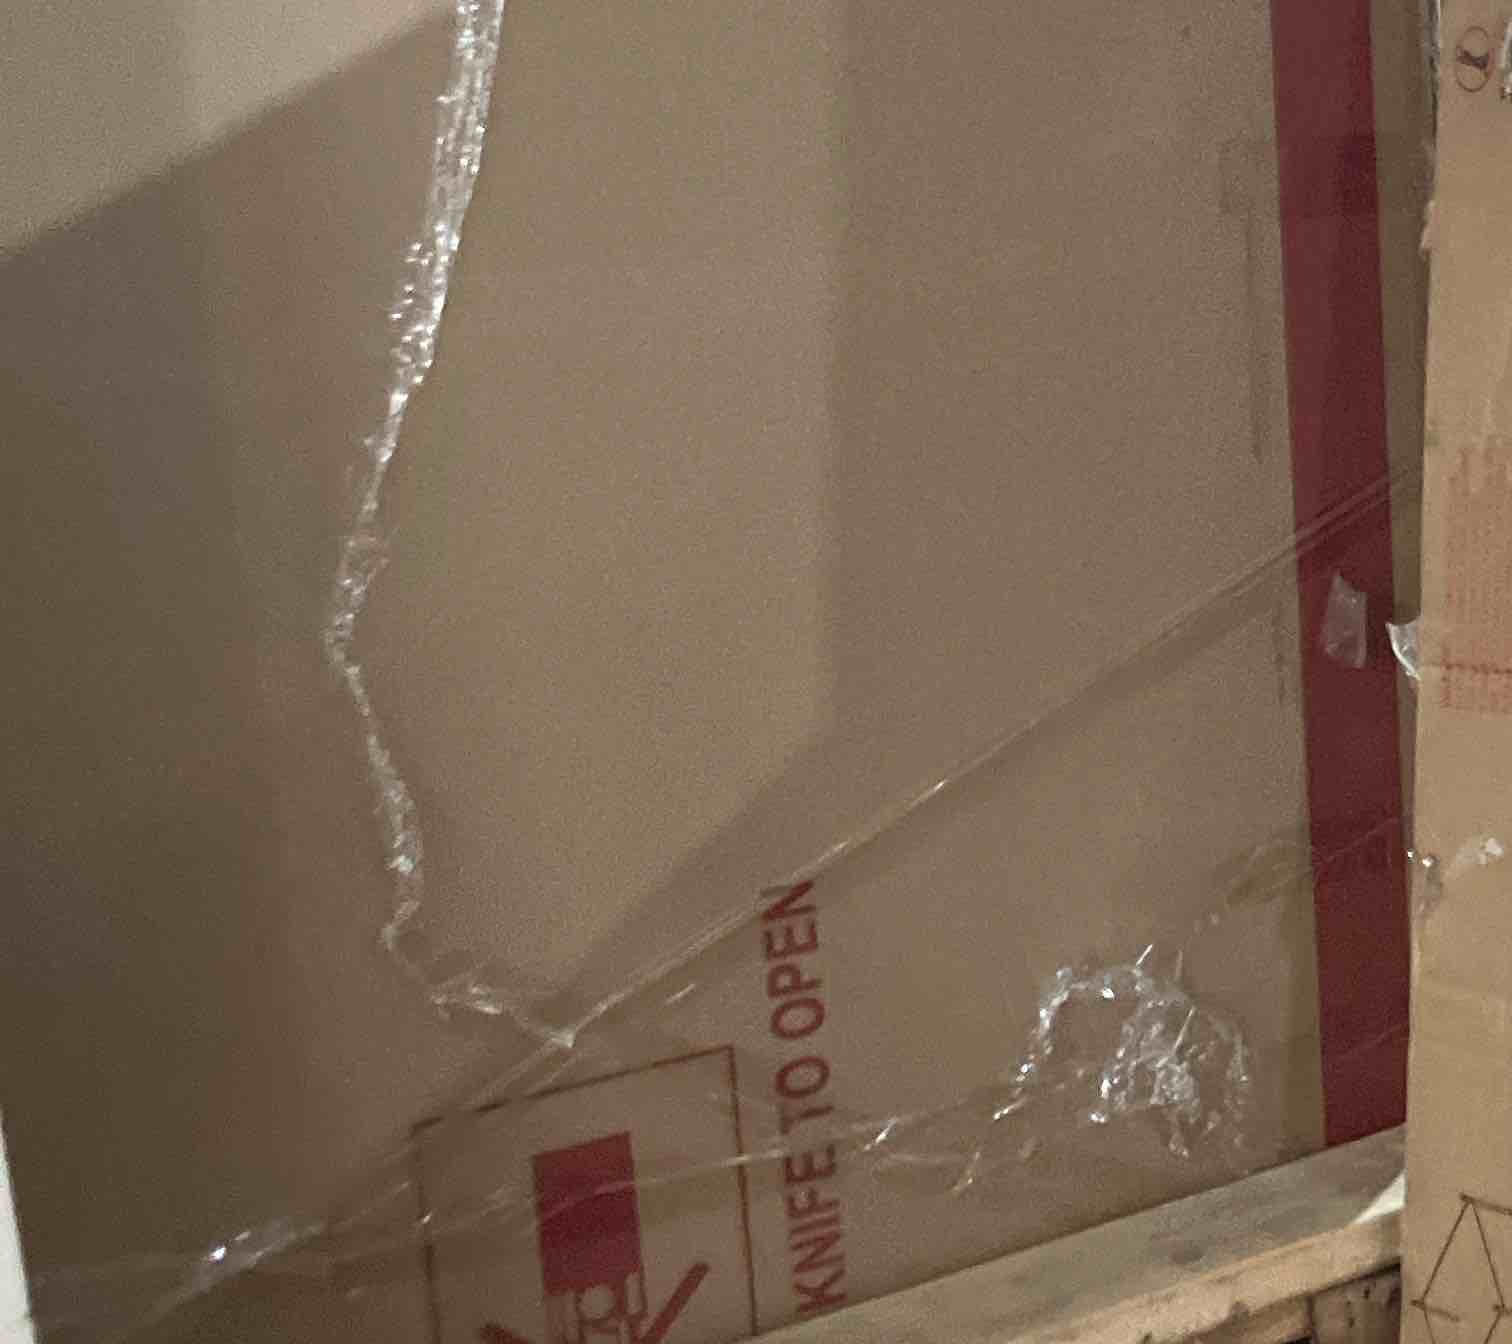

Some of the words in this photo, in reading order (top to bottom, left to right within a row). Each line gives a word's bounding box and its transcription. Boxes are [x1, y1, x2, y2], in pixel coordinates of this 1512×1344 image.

[761, 878, 827, 1041] OPEN
[775, 1054, 835, 1137] TO
[784, 1141, 848, 1314] KNIFE
